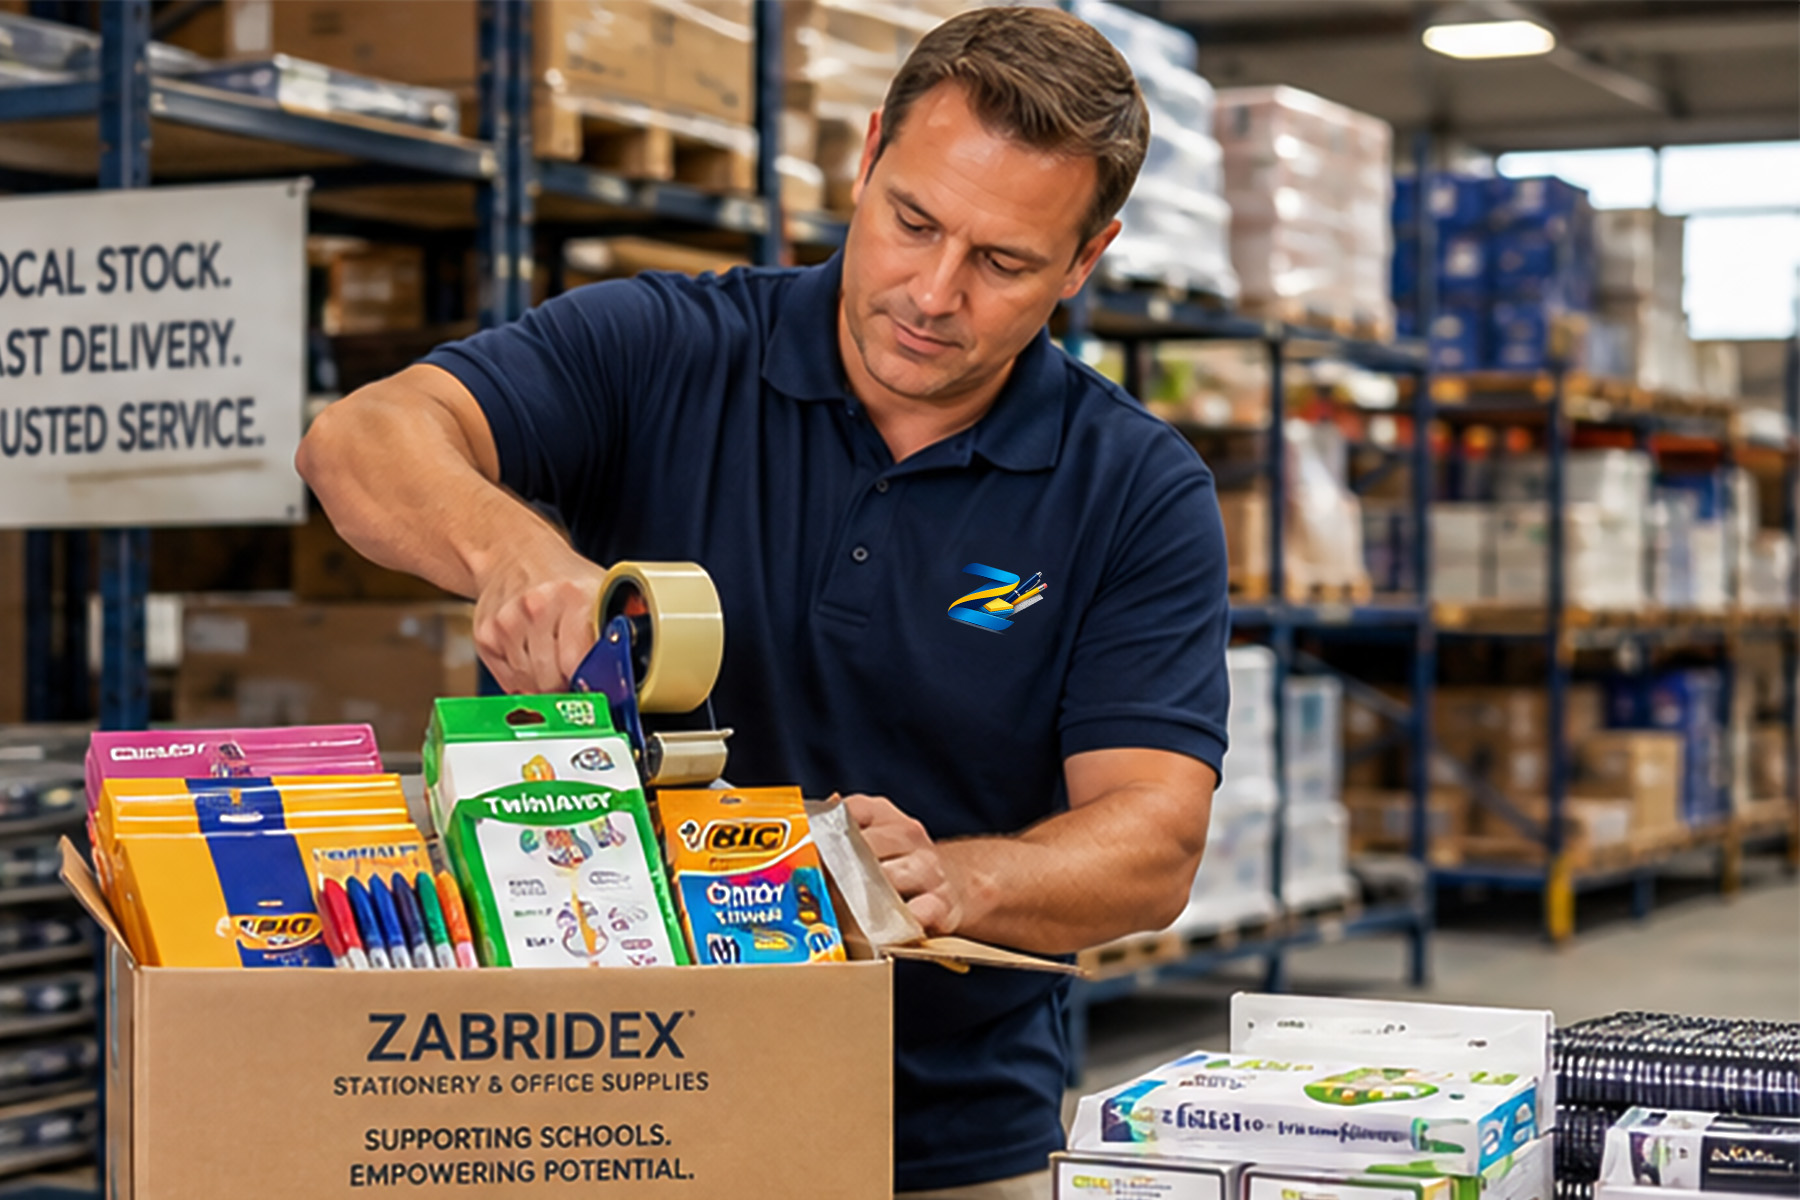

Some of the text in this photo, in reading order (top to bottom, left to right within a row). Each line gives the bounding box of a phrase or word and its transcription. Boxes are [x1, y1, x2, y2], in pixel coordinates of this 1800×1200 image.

[97, 241, 231, 294] STOCK.
[0, 318, 241, 378] ST DELIVERY.
[118, 397, 265, 453] SERVICE.
[366, 1010, 686, 1062] ZABRIDEX
[333, 1071, 709, 1096] STATIONERY & OFFICE SUPPLIES
[365, 1123, 672, 1152] SUPPORTING SCHOOLS.
[350, 1157, 695, 1187] EMPOWERING POTENTIAL.
